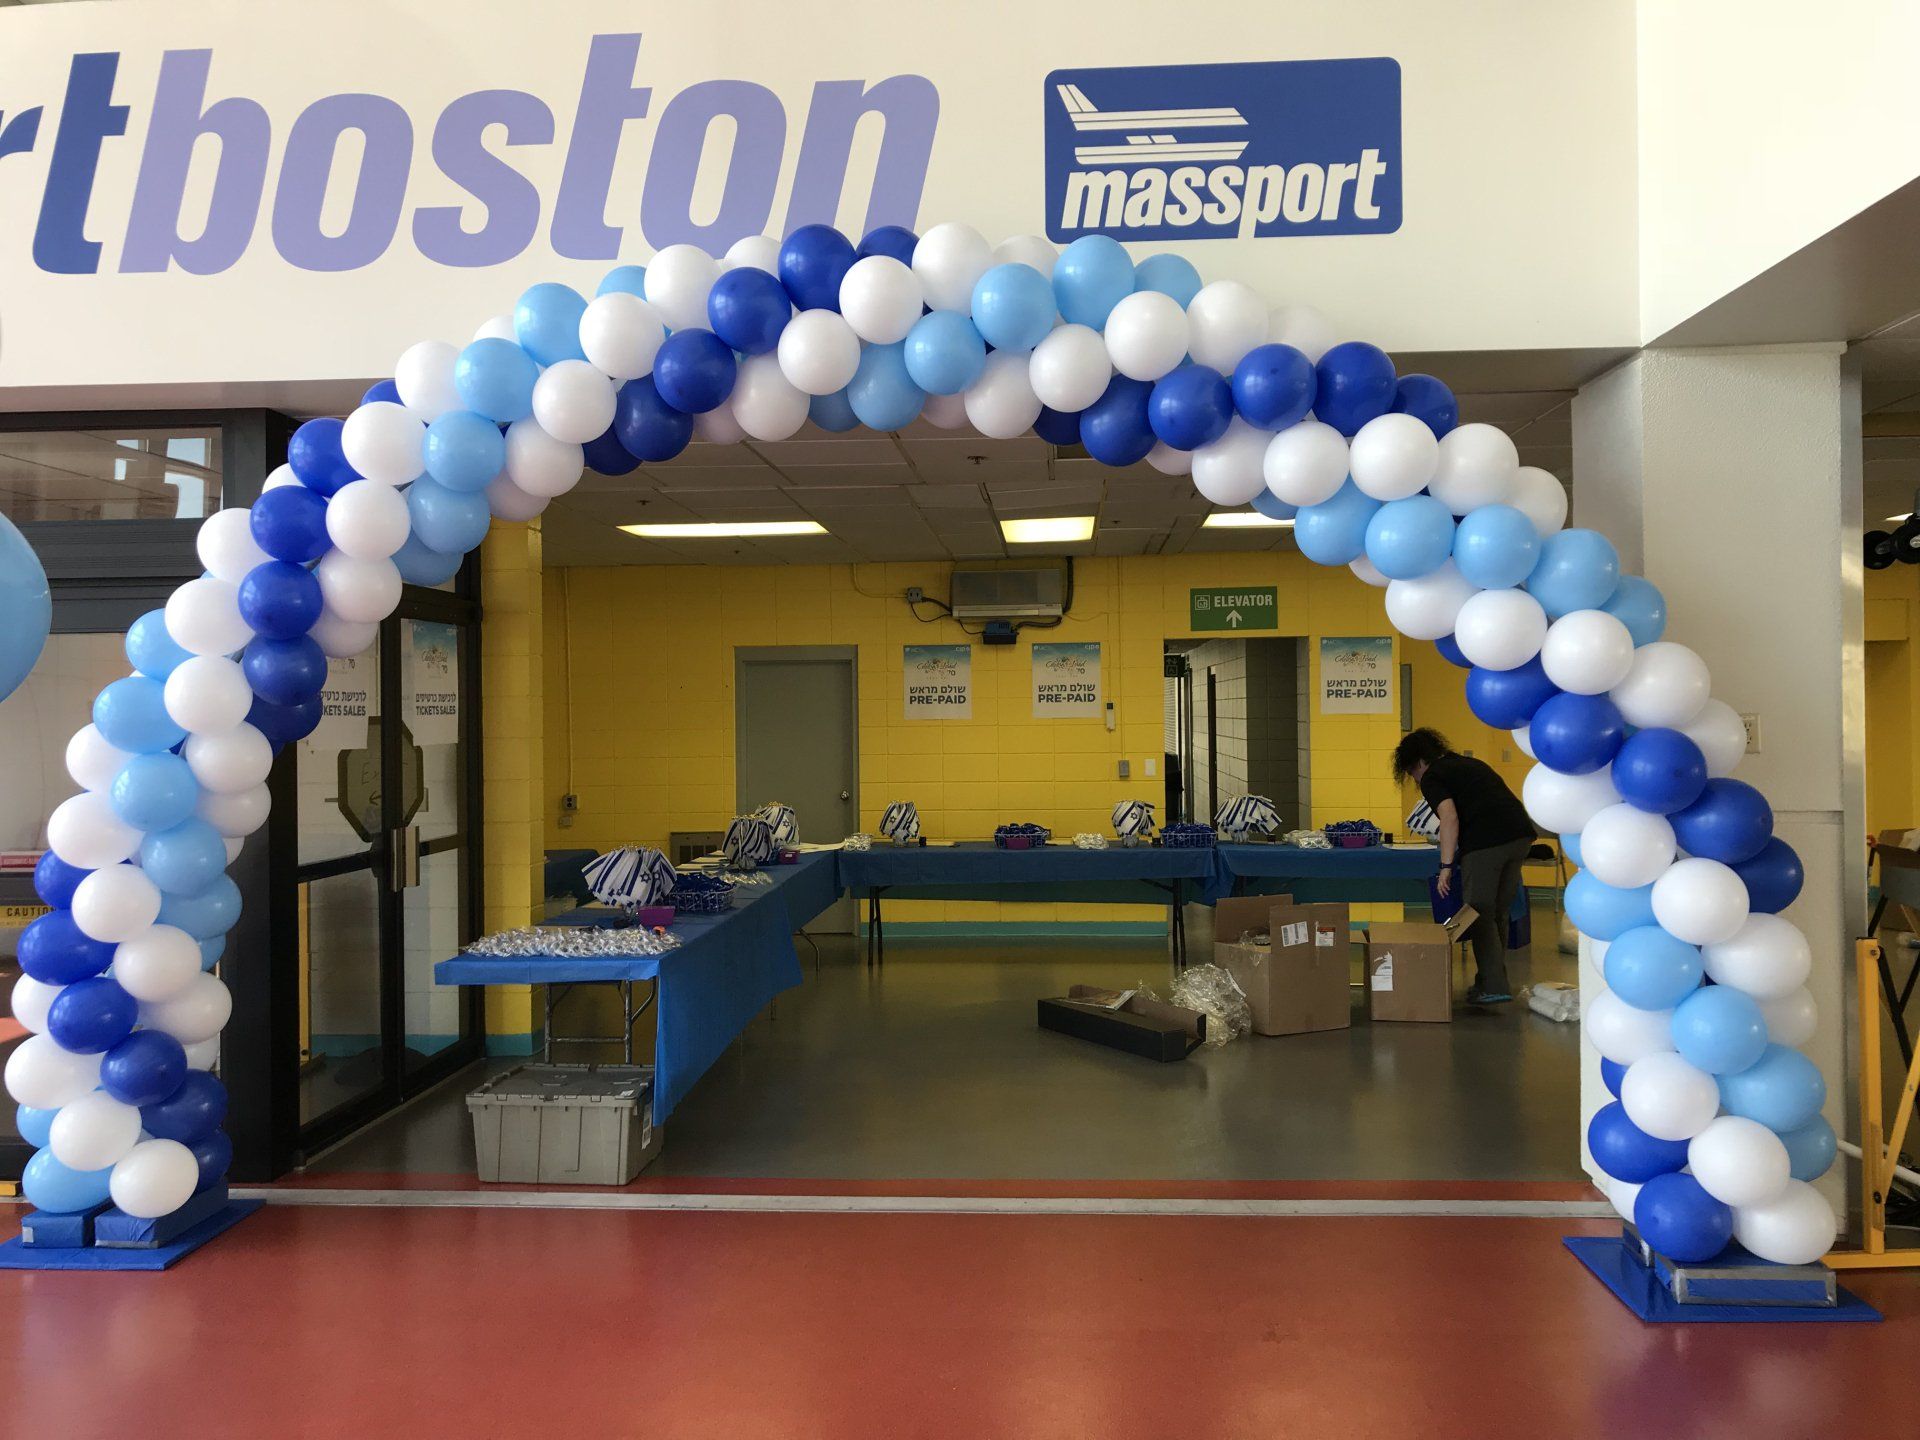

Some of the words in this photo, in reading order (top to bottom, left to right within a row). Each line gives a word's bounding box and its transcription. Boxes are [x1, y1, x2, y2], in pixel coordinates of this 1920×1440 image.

[1061, 148, 1386, 238] massport
[1214, 594, 1273, 607] ELEVATOR
[1327, 679, 1357, 688] מראש
[1360, 678, 1387, 687] שולם
[909, 686, 938, 694] מראש
[941, 685, 966, 694] שולם
[1038, 684, 1067, 692] מראש
[1069, 683, 1096, 692] שולם
[1038, 693, 1096, 703] PRE-PAID
[1327, 689, 1387, 698] PRE-PAID
[909, 695, 966, 704] PRE-PAID
[323, 704, 342, 716] KETS
[343, 705, 366, 716] SALES
[416, 706, 440, 716] TICKETS
[440, 705, 456, 715] SALES
[6, 907, 56, 917] CAUTIO
